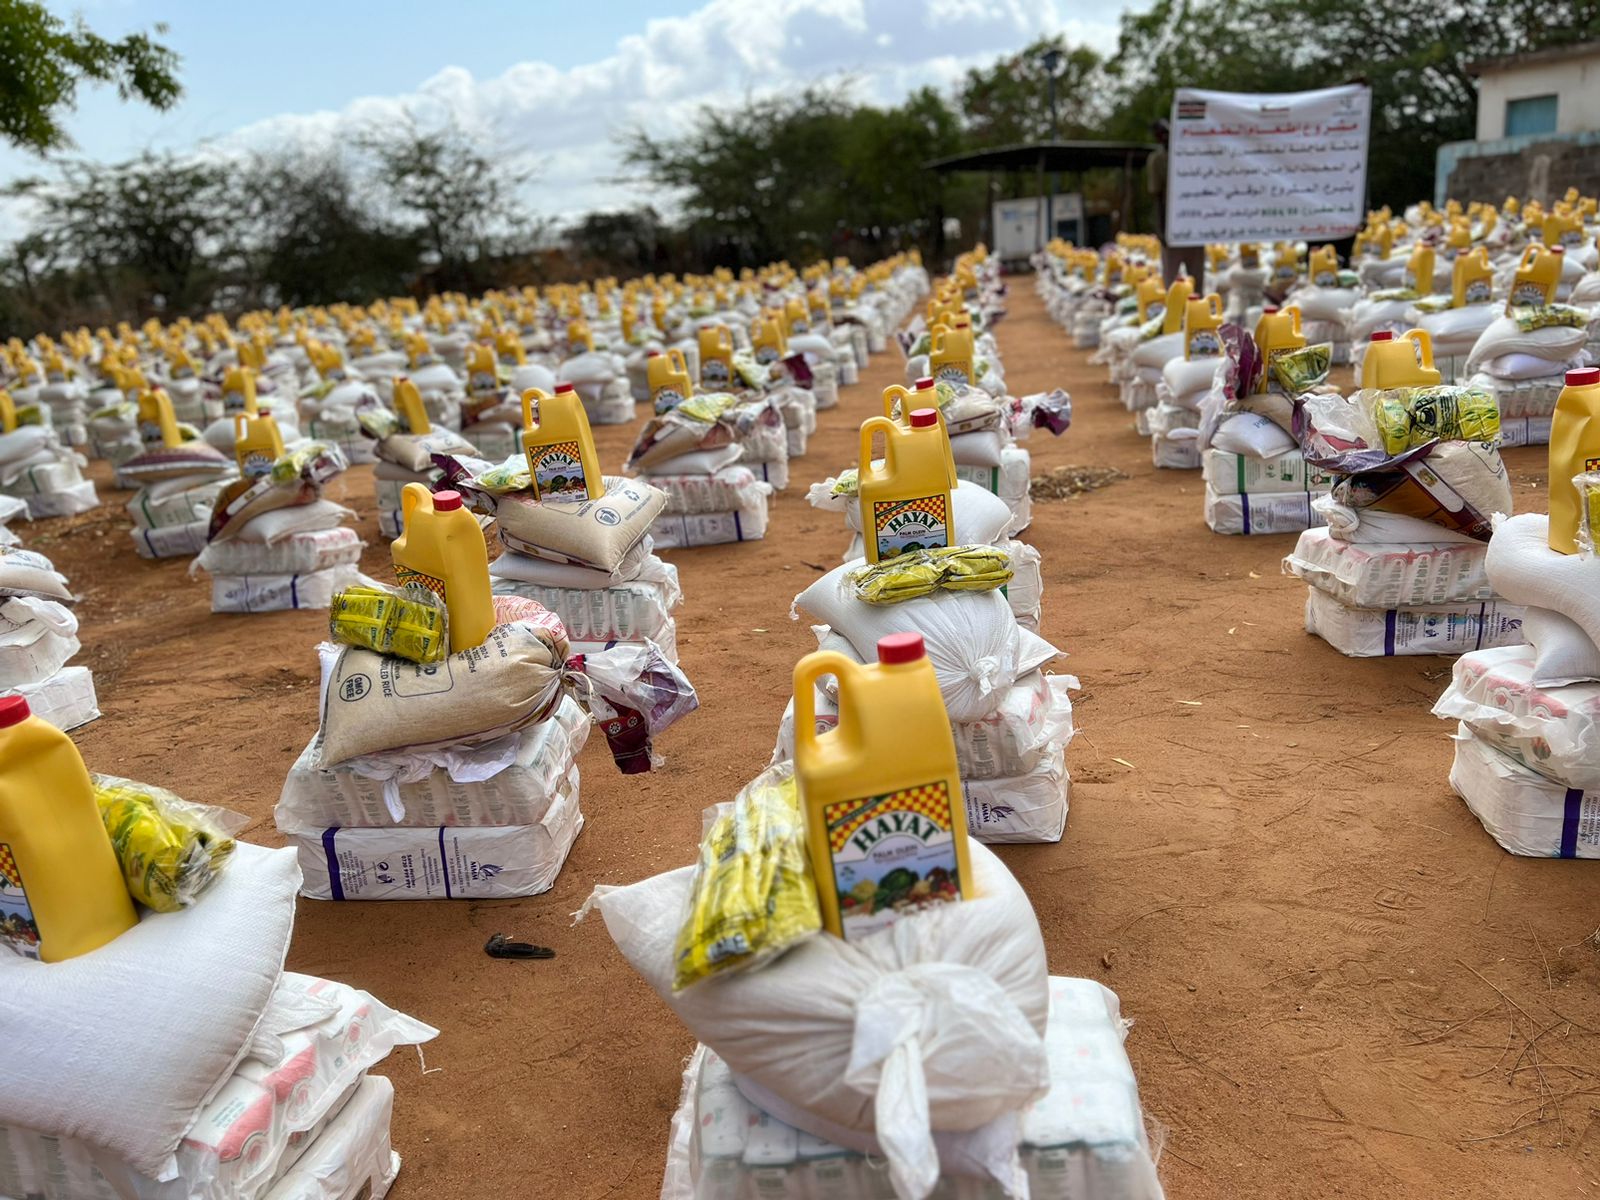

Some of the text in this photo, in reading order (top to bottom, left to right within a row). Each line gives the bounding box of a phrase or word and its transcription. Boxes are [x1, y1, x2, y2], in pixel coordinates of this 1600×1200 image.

[540, 453, 576, 469] HAYAT
[888, 512, 939, 533] HAYAT
[344, 680, 355, 699] FREE
[353, 677, 364, 695] GMO
[382, 681, 392, 698] RICE
[851, 813, 940, 853] HAYAT
[471, 861, 479, 881] MMM
